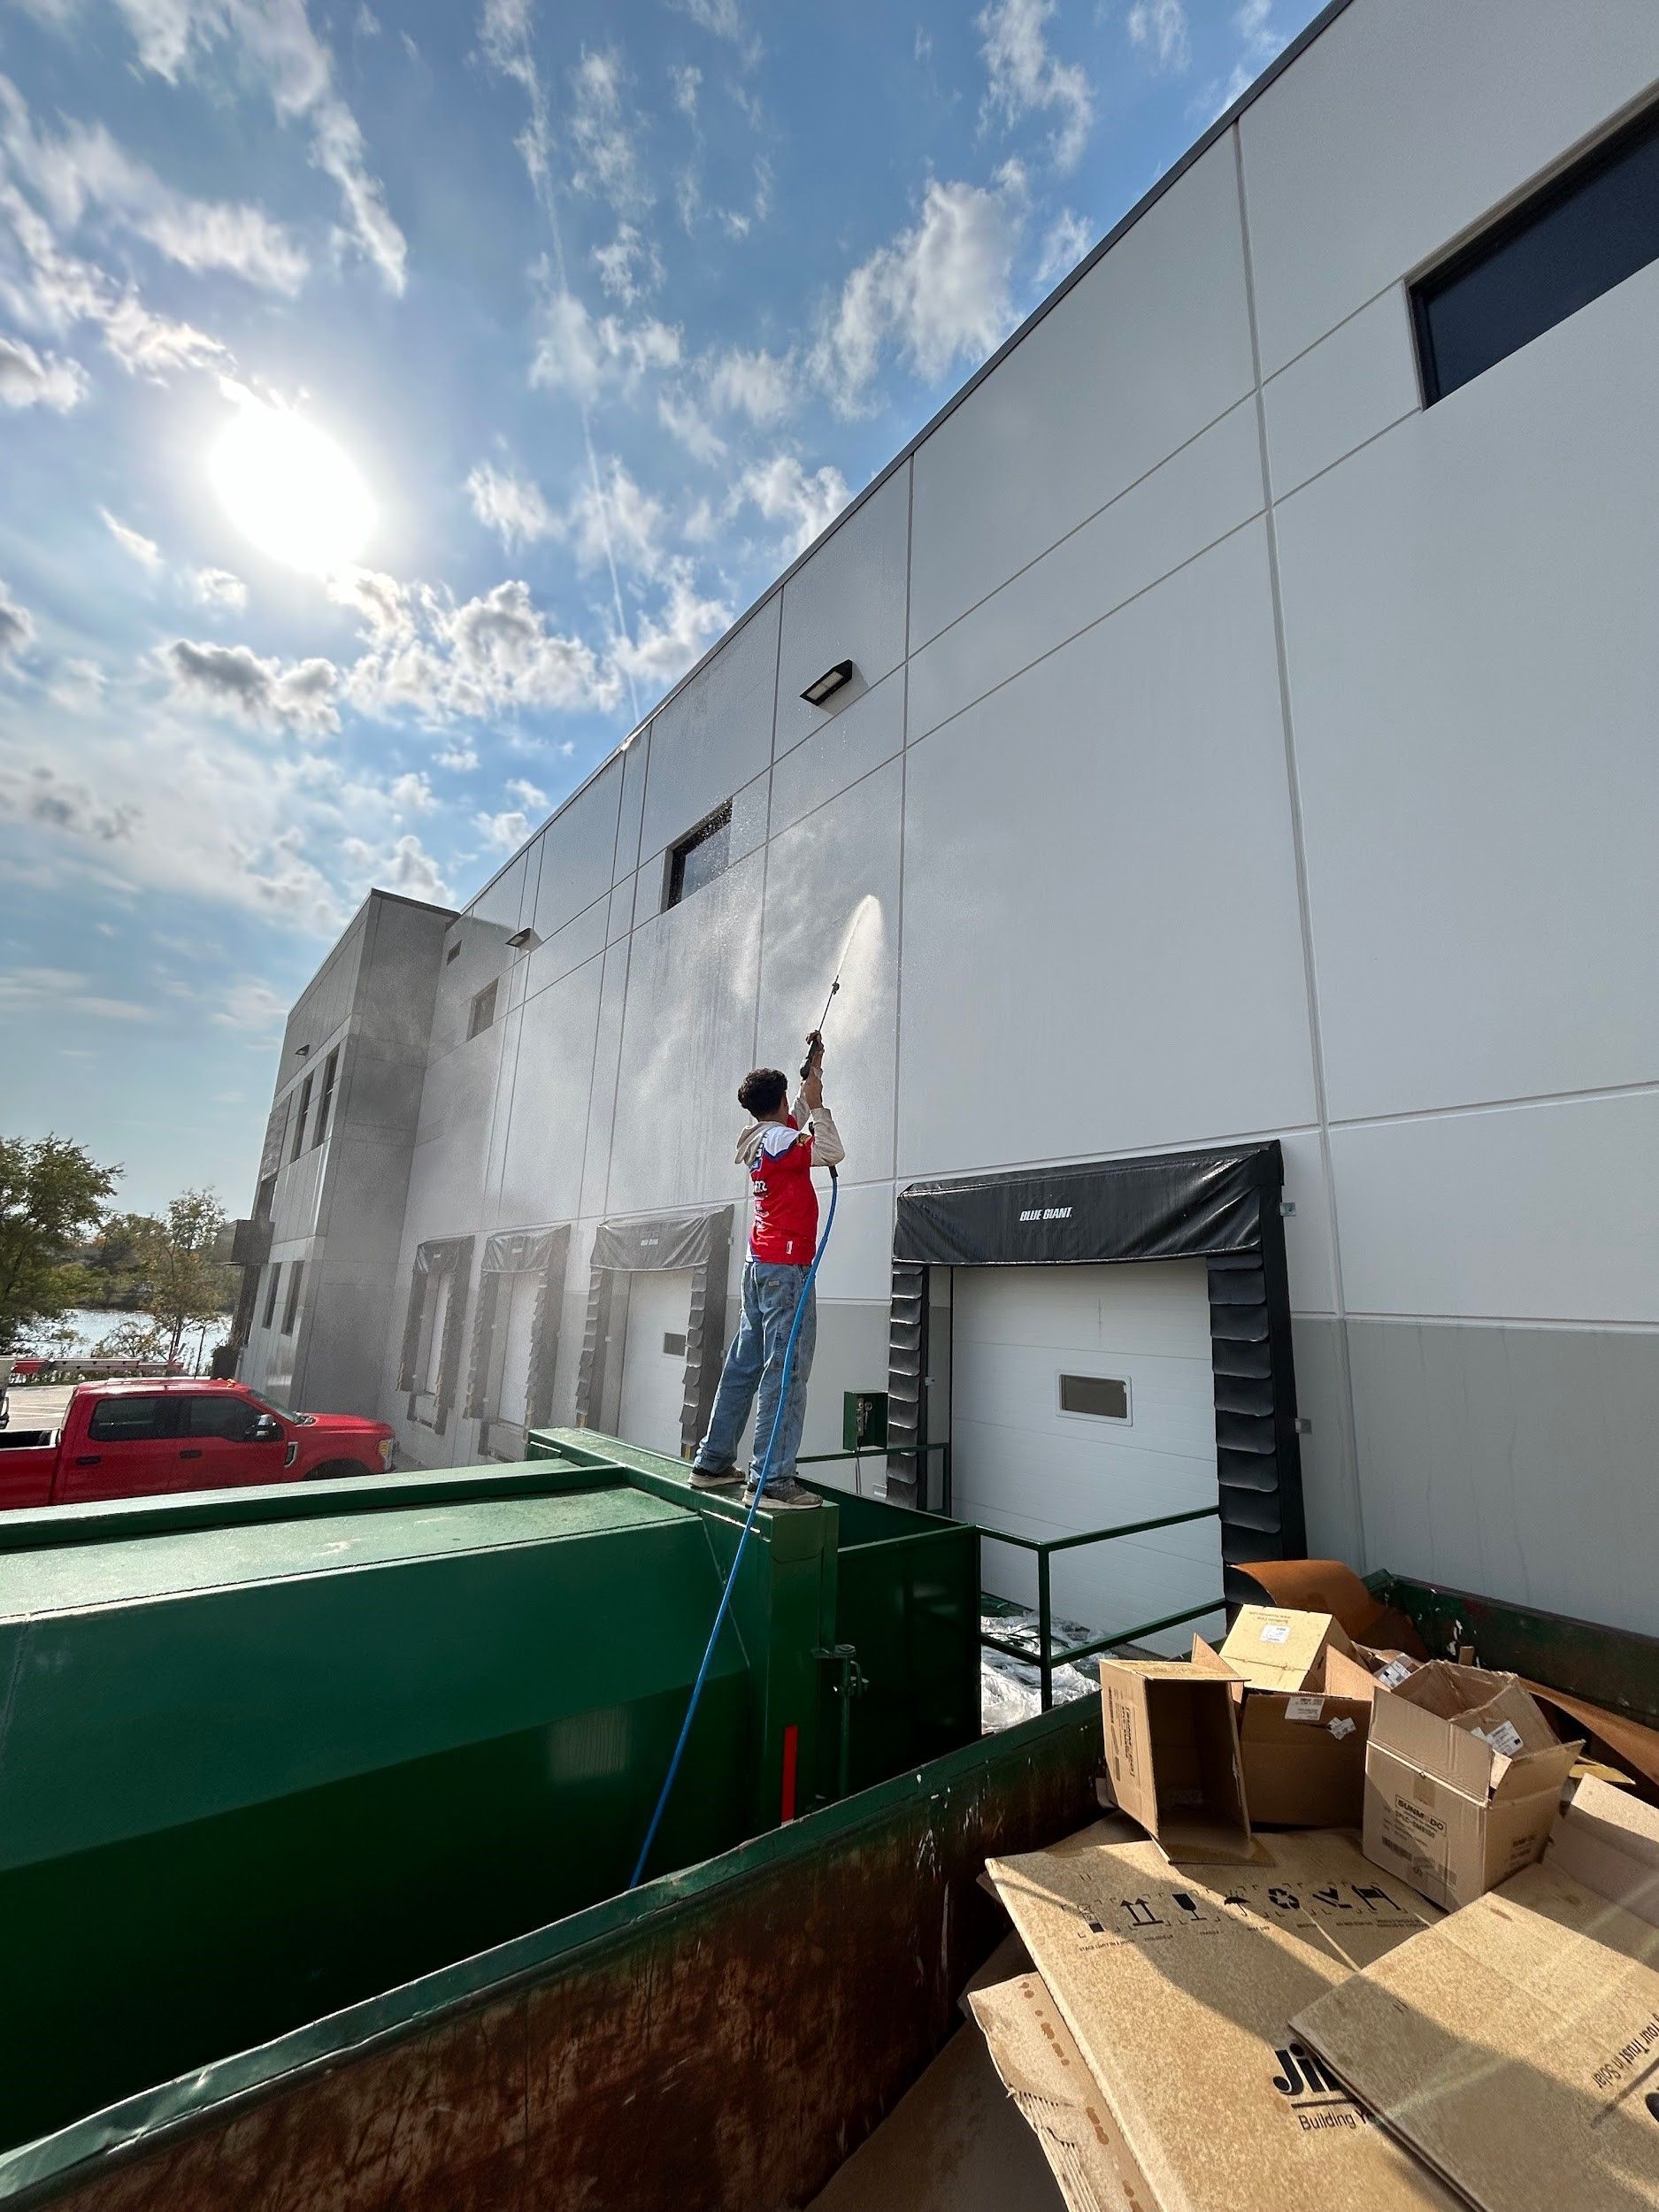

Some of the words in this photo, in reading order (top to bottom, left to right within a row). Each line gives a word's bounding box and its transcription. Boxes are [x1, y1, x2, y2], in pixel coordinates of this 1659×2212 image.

[1019, 1210, 1042, 1221] BLUE
[1043, 1207, 1072, 1219] GIANT
[1619, 2039, 1650, 2065] Trust
[1593, 2063, 1622, 2088] Solar
[1298, 2113, 1356, 2131] Building
